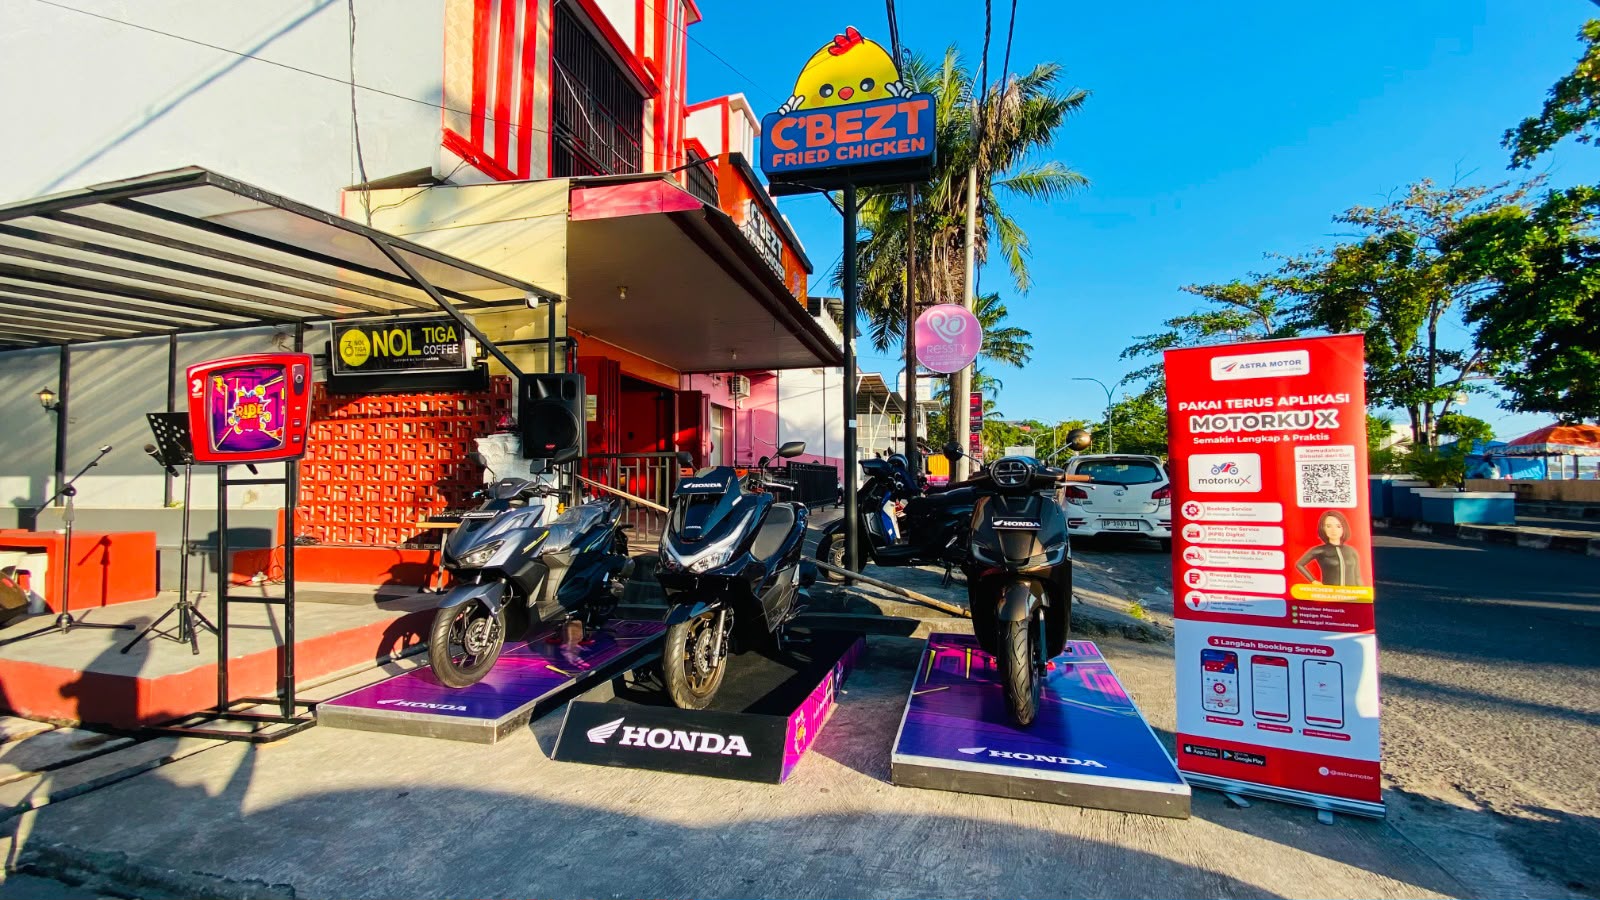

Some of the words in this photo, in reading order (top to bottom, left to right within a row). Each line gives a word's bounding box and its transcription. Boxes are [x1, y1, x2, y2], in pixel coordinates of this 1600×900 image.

[771, 100, 929, 150] C'BEZT
[772, 149, 830, 167] FRIED
[836, 137, 925, 160] CHICKEN
[372, 329, 422, 357] NOL
[422, 326, 458, 344] TIGA
[423, 344, 459, 354] COFFEE
[1239, 362, 1268, 370] ASTRA
[1269, 359, 1302, 368] MOTOR
[1178, 400, 1222, 411] PAKAI
[1225, 397, 1274, 409] TERUS
[1278, 393, 1350, 406] APLIKASI
[1191, 411, 1312, 432] MOTORKU
[1315, 410, 1338, 429] X
[1193, 436, 1234, 444] Semakin
[1237, 434, 1280, 444] Lengkap
[1282, 433, 1290, 442] &
[1293, 432, 1330, 442] Praktis
[1220, 639, 1256, 648] Langkah
[1258, 643, 1293, 653] Booking
[1295, 646, 1327, 654] Service
[394, 701, 467, 711] HONDA
[619, 726, 752, 756] HONDA
[988, 750, 1108, 768] HONDA
